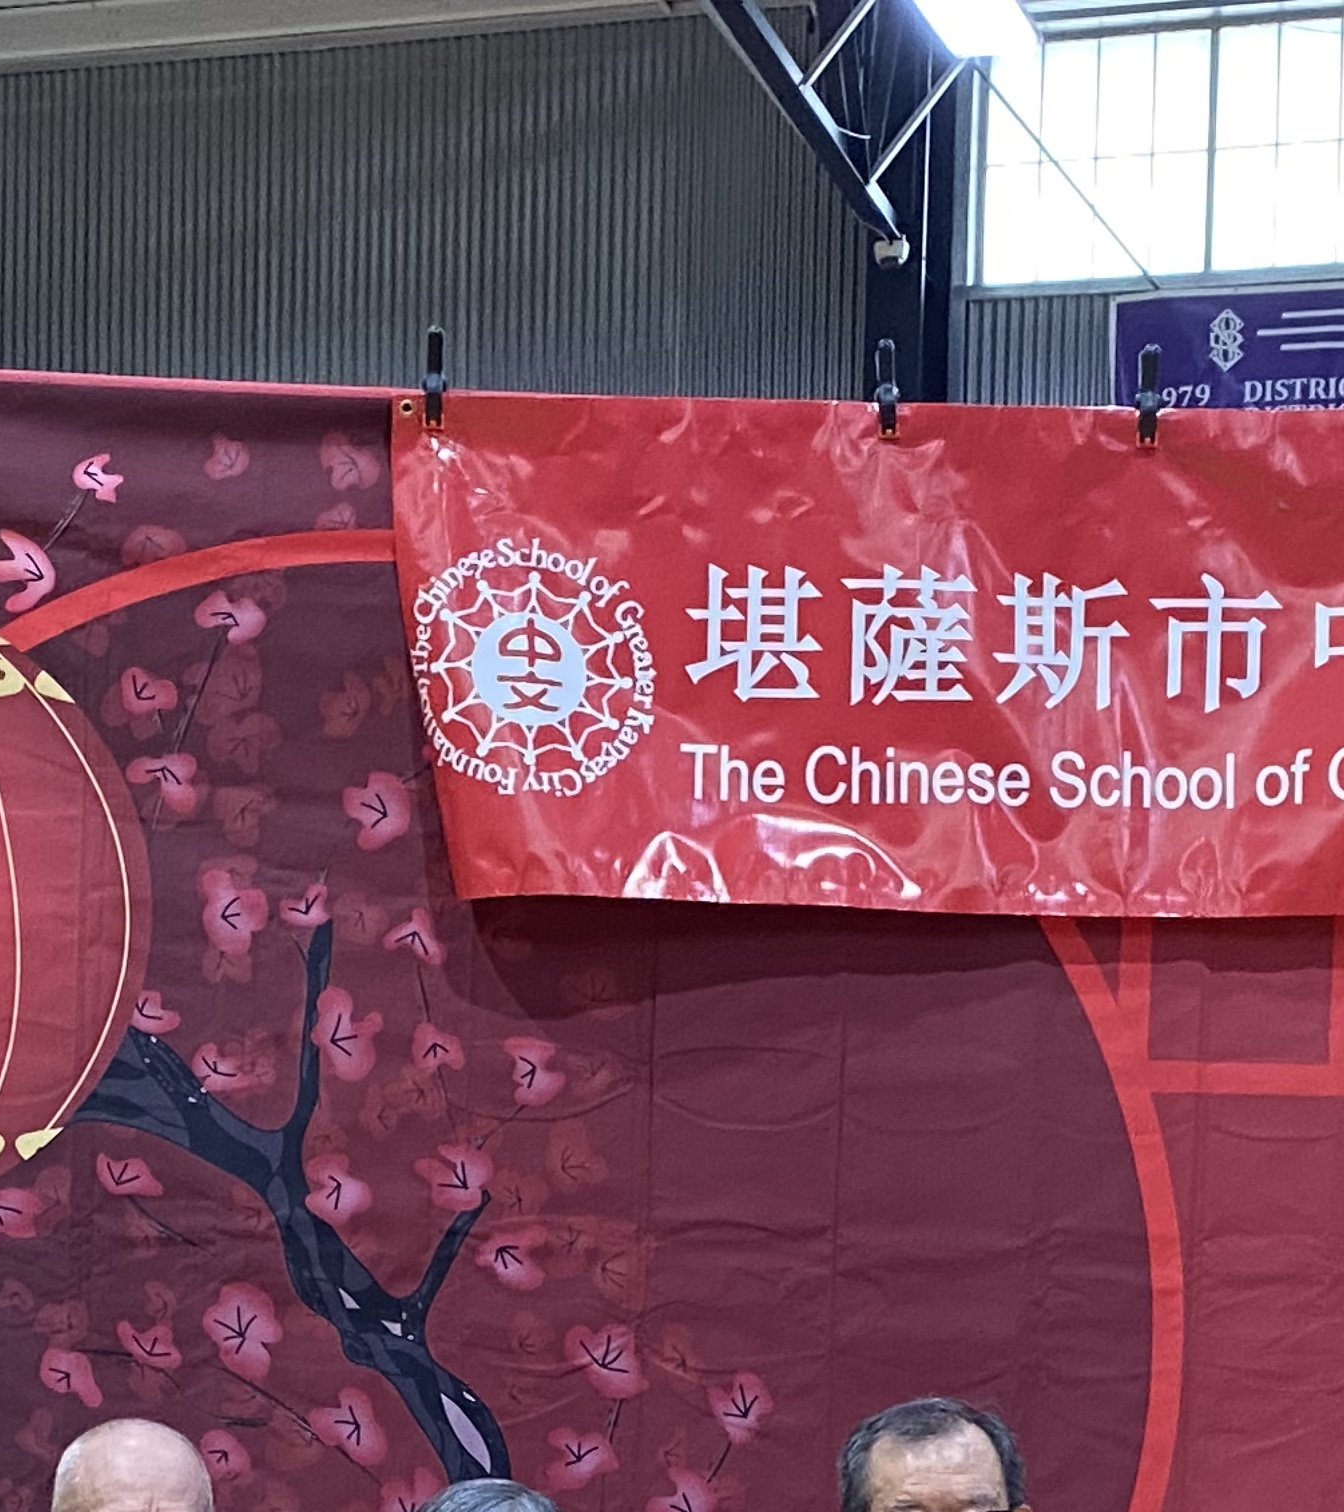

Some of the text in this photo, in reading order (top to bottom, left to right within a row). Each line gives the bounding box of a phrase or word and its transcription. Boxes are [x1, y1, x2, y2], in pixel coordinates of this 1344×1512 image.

[1162, 384, 1211, 408] 979
[413, 549, 497, 624] Chinese
[496, 538, 597, 588] School
[589, 575, 630, 608] of
[615, 600, 657, 709] Greater
[582, 706, 654, 783] Kansas
[522, 763, 583, 797] City
[680, 742, 785, 803] The
[805, 745, 1031, 808] Chinese
[1050, 750, 1234, 809] School
[1256, 748, 1312, 808] of
